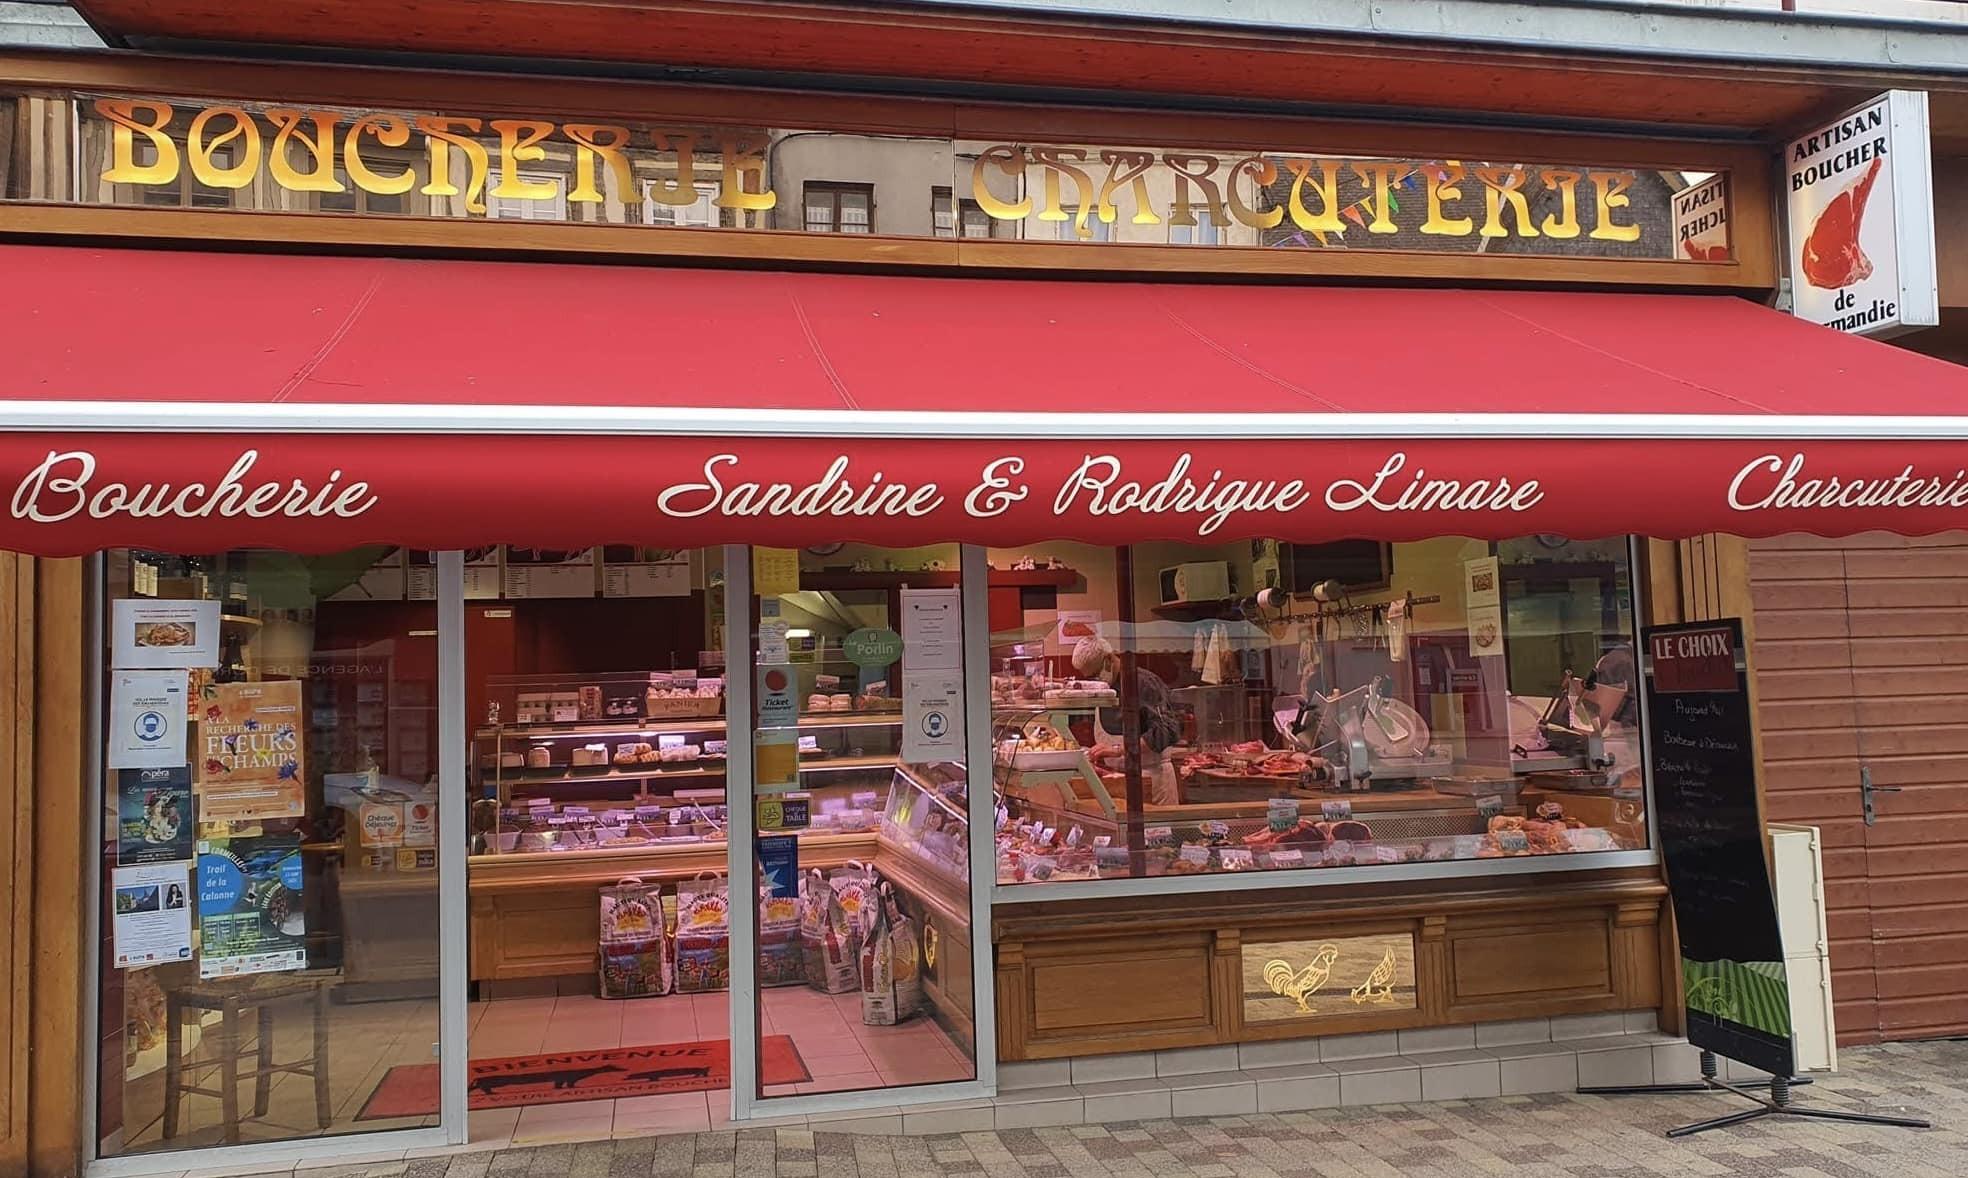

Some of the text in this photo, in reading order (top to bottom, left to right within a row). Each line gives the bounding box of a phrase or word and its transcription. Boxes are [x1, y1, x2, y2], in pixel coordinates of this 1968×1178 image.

[1793, 107, 1883, 162] ARTISAN
[95, 100, 777, 215] BOUCHERIE
[1791, 137, 1888, 192] BOUCHER
[972, 143, 1640, 241] CHARCUTERIE
[1824, 300, 1896, 331] mandie
[1834, 289, 1855, 312] de
[11, 449, 378, 523] Boucherie
[657, 452, 1544, 536] Sandrine & Rodrigue Limare
[1727, 453, 1968, 511] Charcuterie
[1655, 633, 1730, 660] LE CHOIX
[206, 723, 273, 735] RECHERHE
[207, 864, 226, 873] Trail
[218, 878, 227, 886] la
[472, 1048, 714, 1074] BIENVENUE
[648, 1077, 728, 1091] BOUCHE
